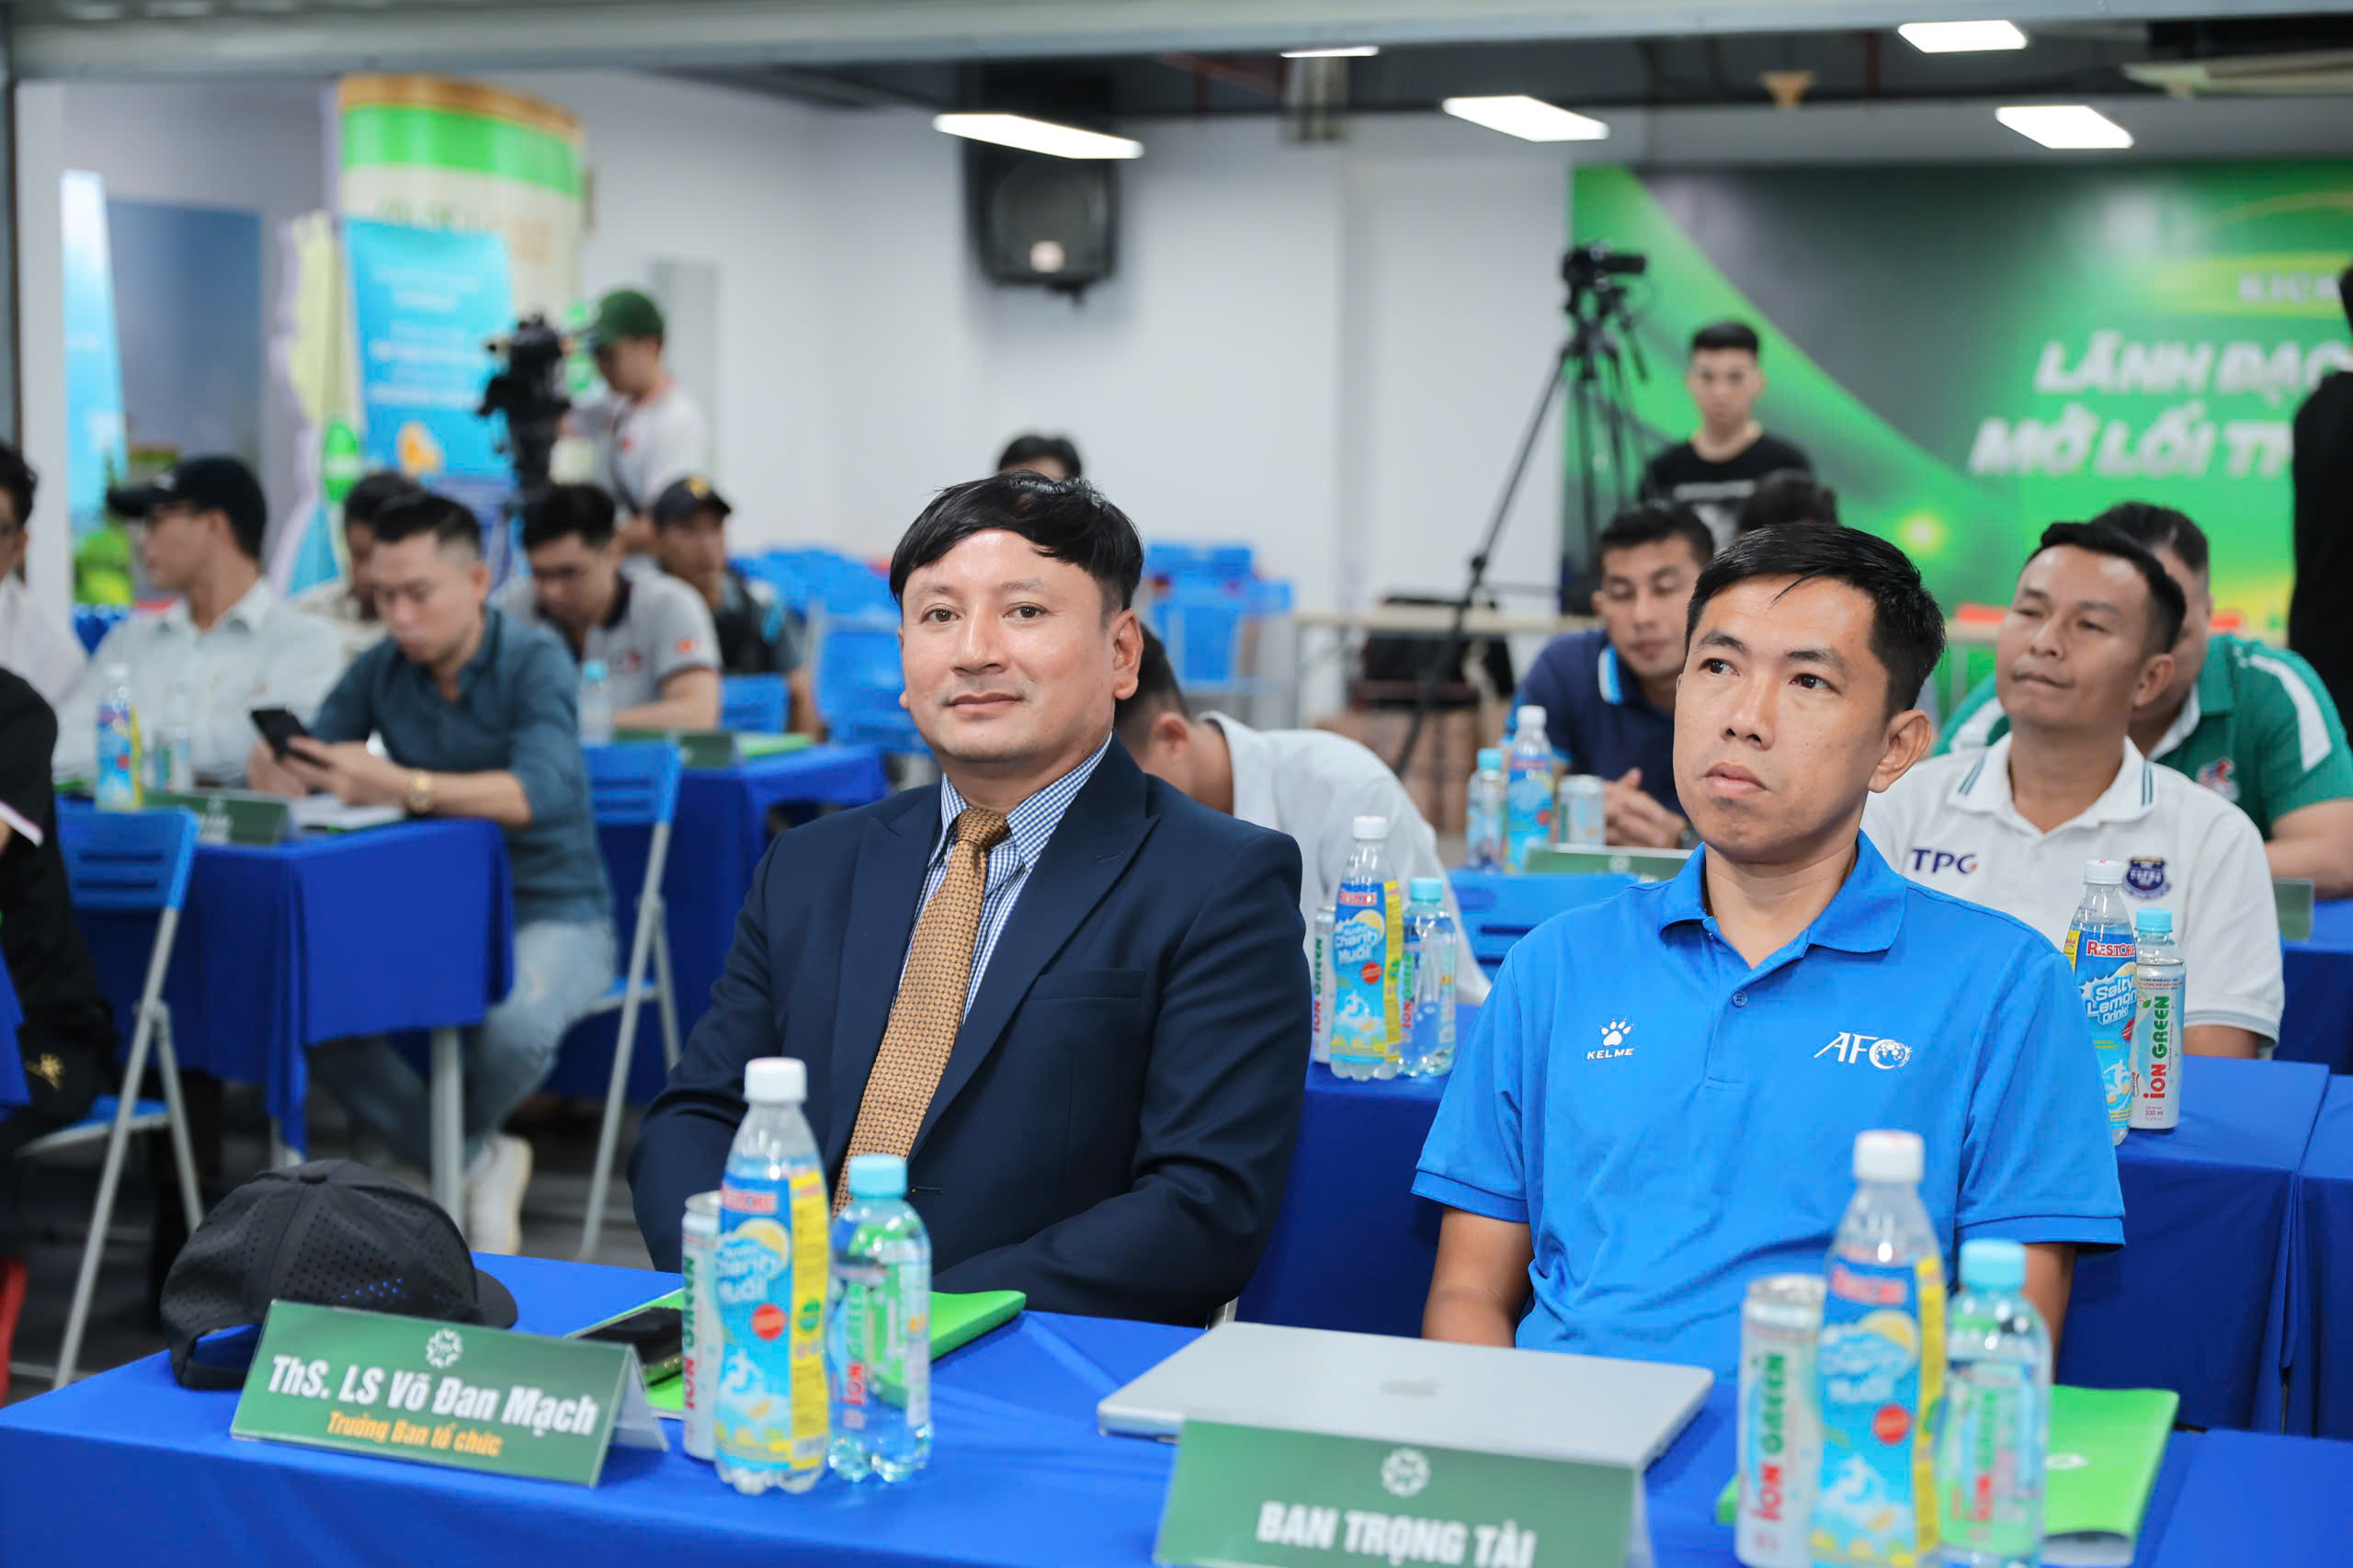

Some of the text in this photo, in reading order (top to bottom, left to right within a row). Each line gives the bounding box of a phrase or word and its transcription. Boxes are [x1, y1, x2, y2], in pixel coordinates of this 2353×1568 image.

[2033, 329, 2215, 395] LÃNH
[2094, 398, 2217, 478] LỐI
[2087, 989, 2137, 1015] Lemon
[2096, 975, 2133, 1002] Salty
[1813, 1030, 1913, 1070] AFC
[2152, 996, 2169, 1059] GREEN
[1587, 1048, 1634, 1060] KELME
[267, 1355, 600, 1437] ThS. LS Võ Đan Mạch
[390, 1419, 430, 1447] Ban
[1256, 1499, 1538, 1568] BAN TRỌNG TÀI
